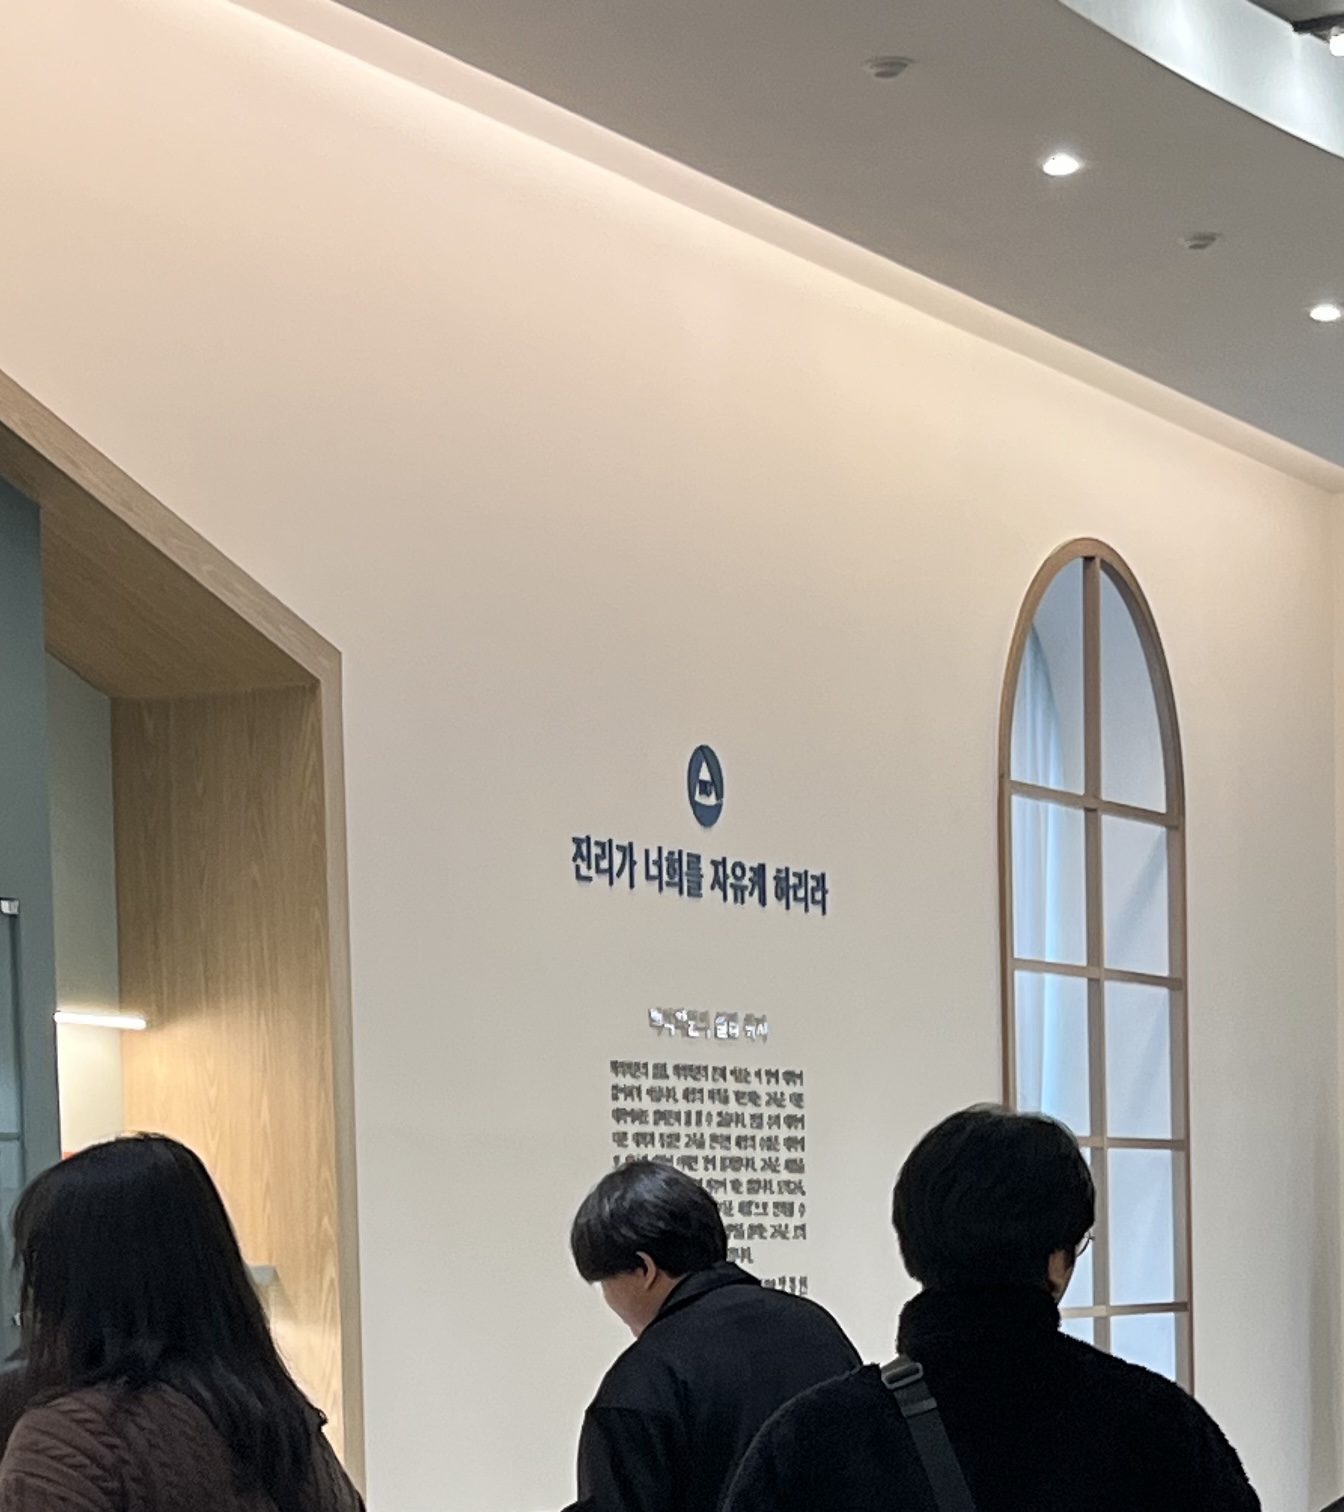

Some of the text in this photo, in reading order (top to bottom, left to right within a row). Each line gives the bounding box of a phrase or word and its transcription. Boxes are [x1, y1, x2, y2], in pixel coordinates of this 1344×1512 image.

[571, 835, 829, 916] 진리가 너희를 자유케 하리라
